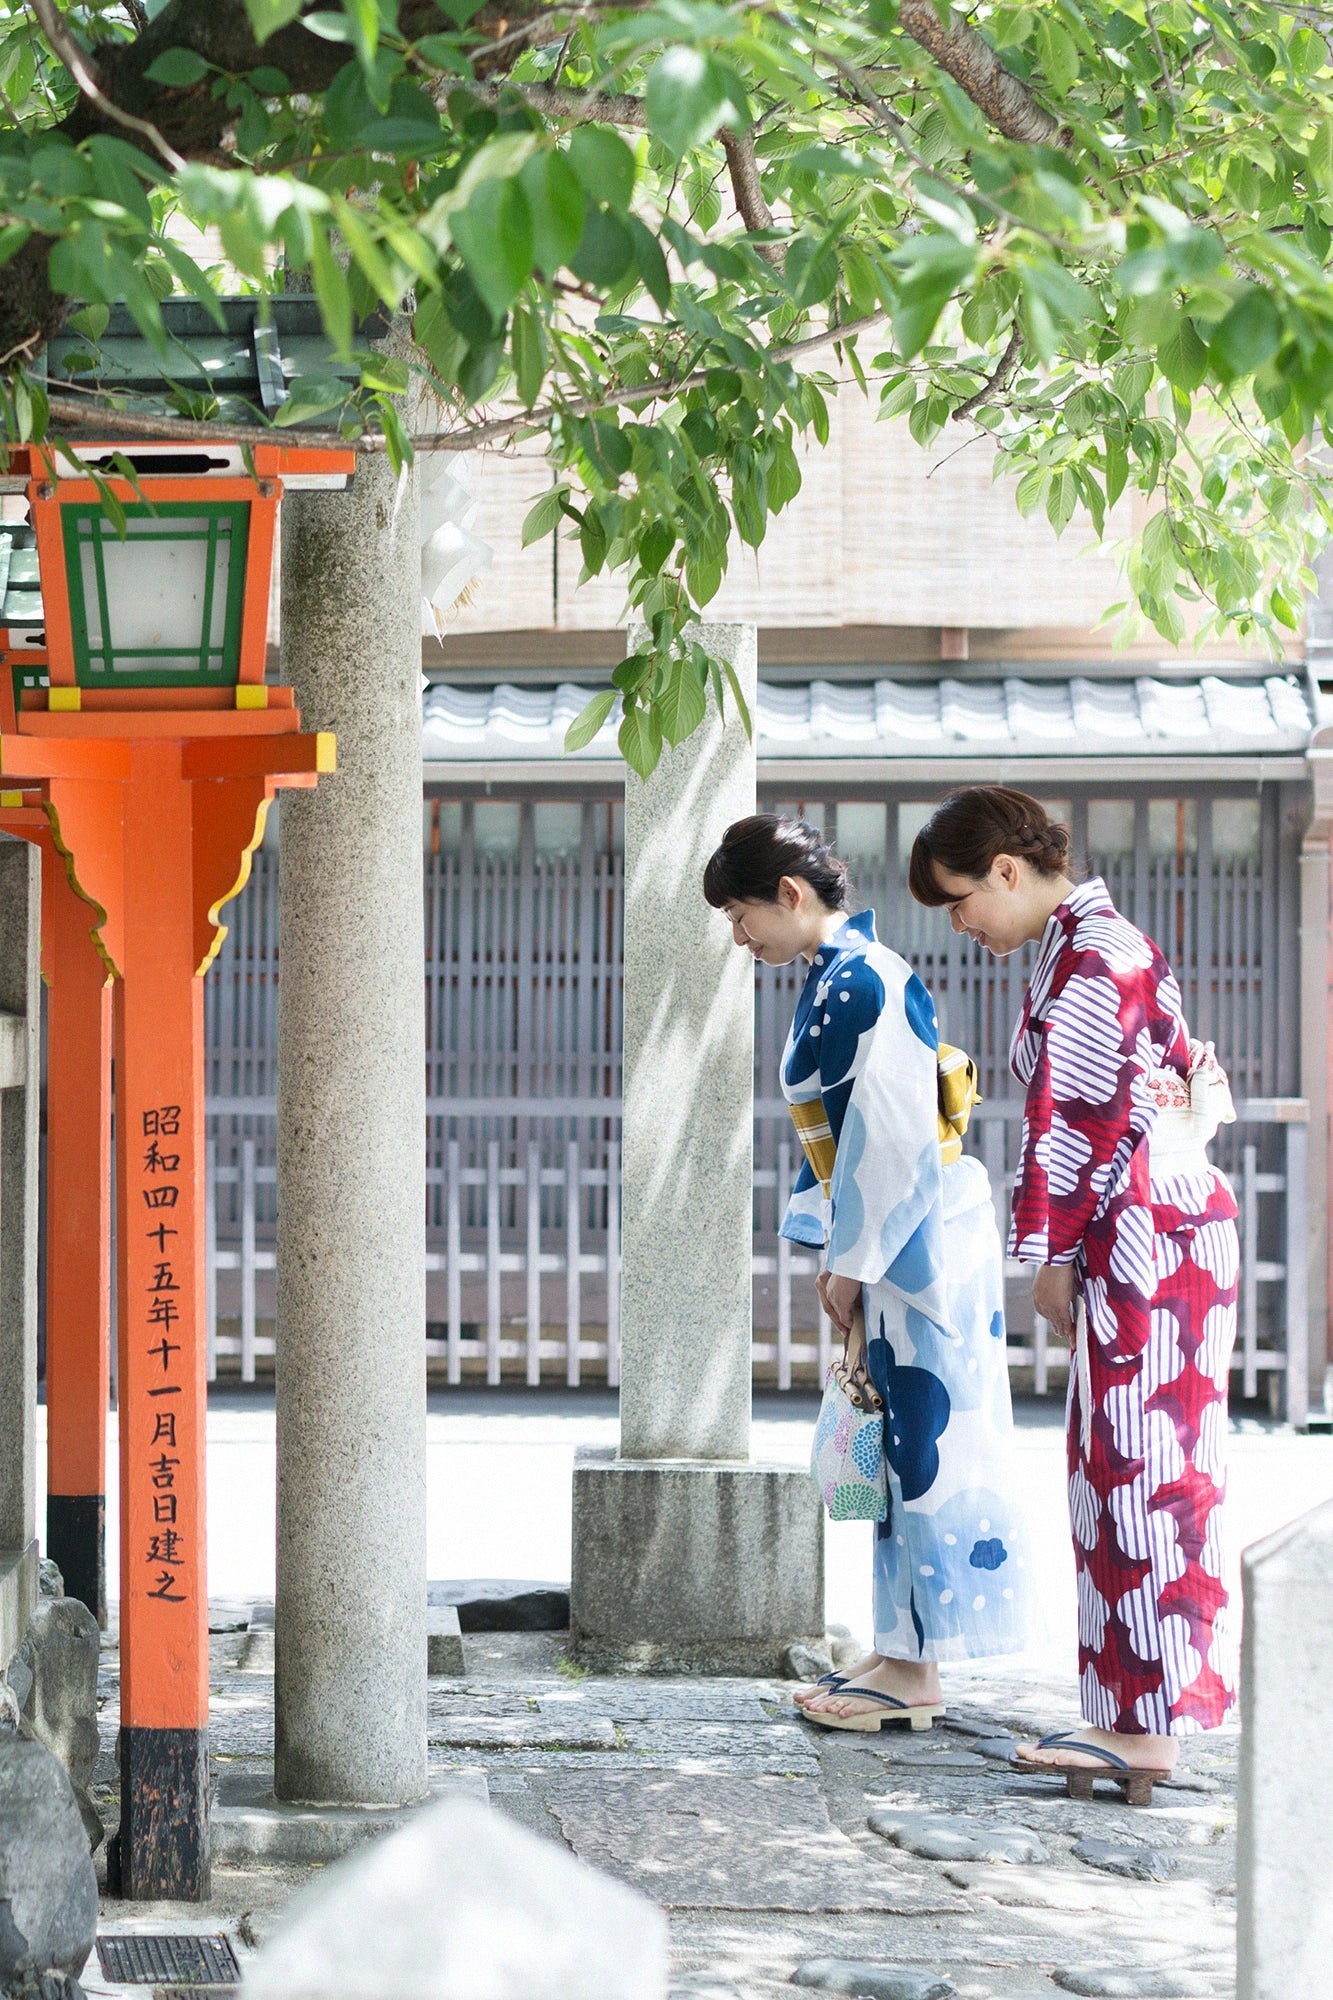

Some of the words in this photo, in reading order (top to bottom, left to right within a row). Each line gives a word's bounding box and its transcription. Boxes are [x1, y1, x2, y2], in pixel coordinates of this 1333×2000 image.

[142, 1105, 187, 1602] 昭和四十五年十一月吉日建之
